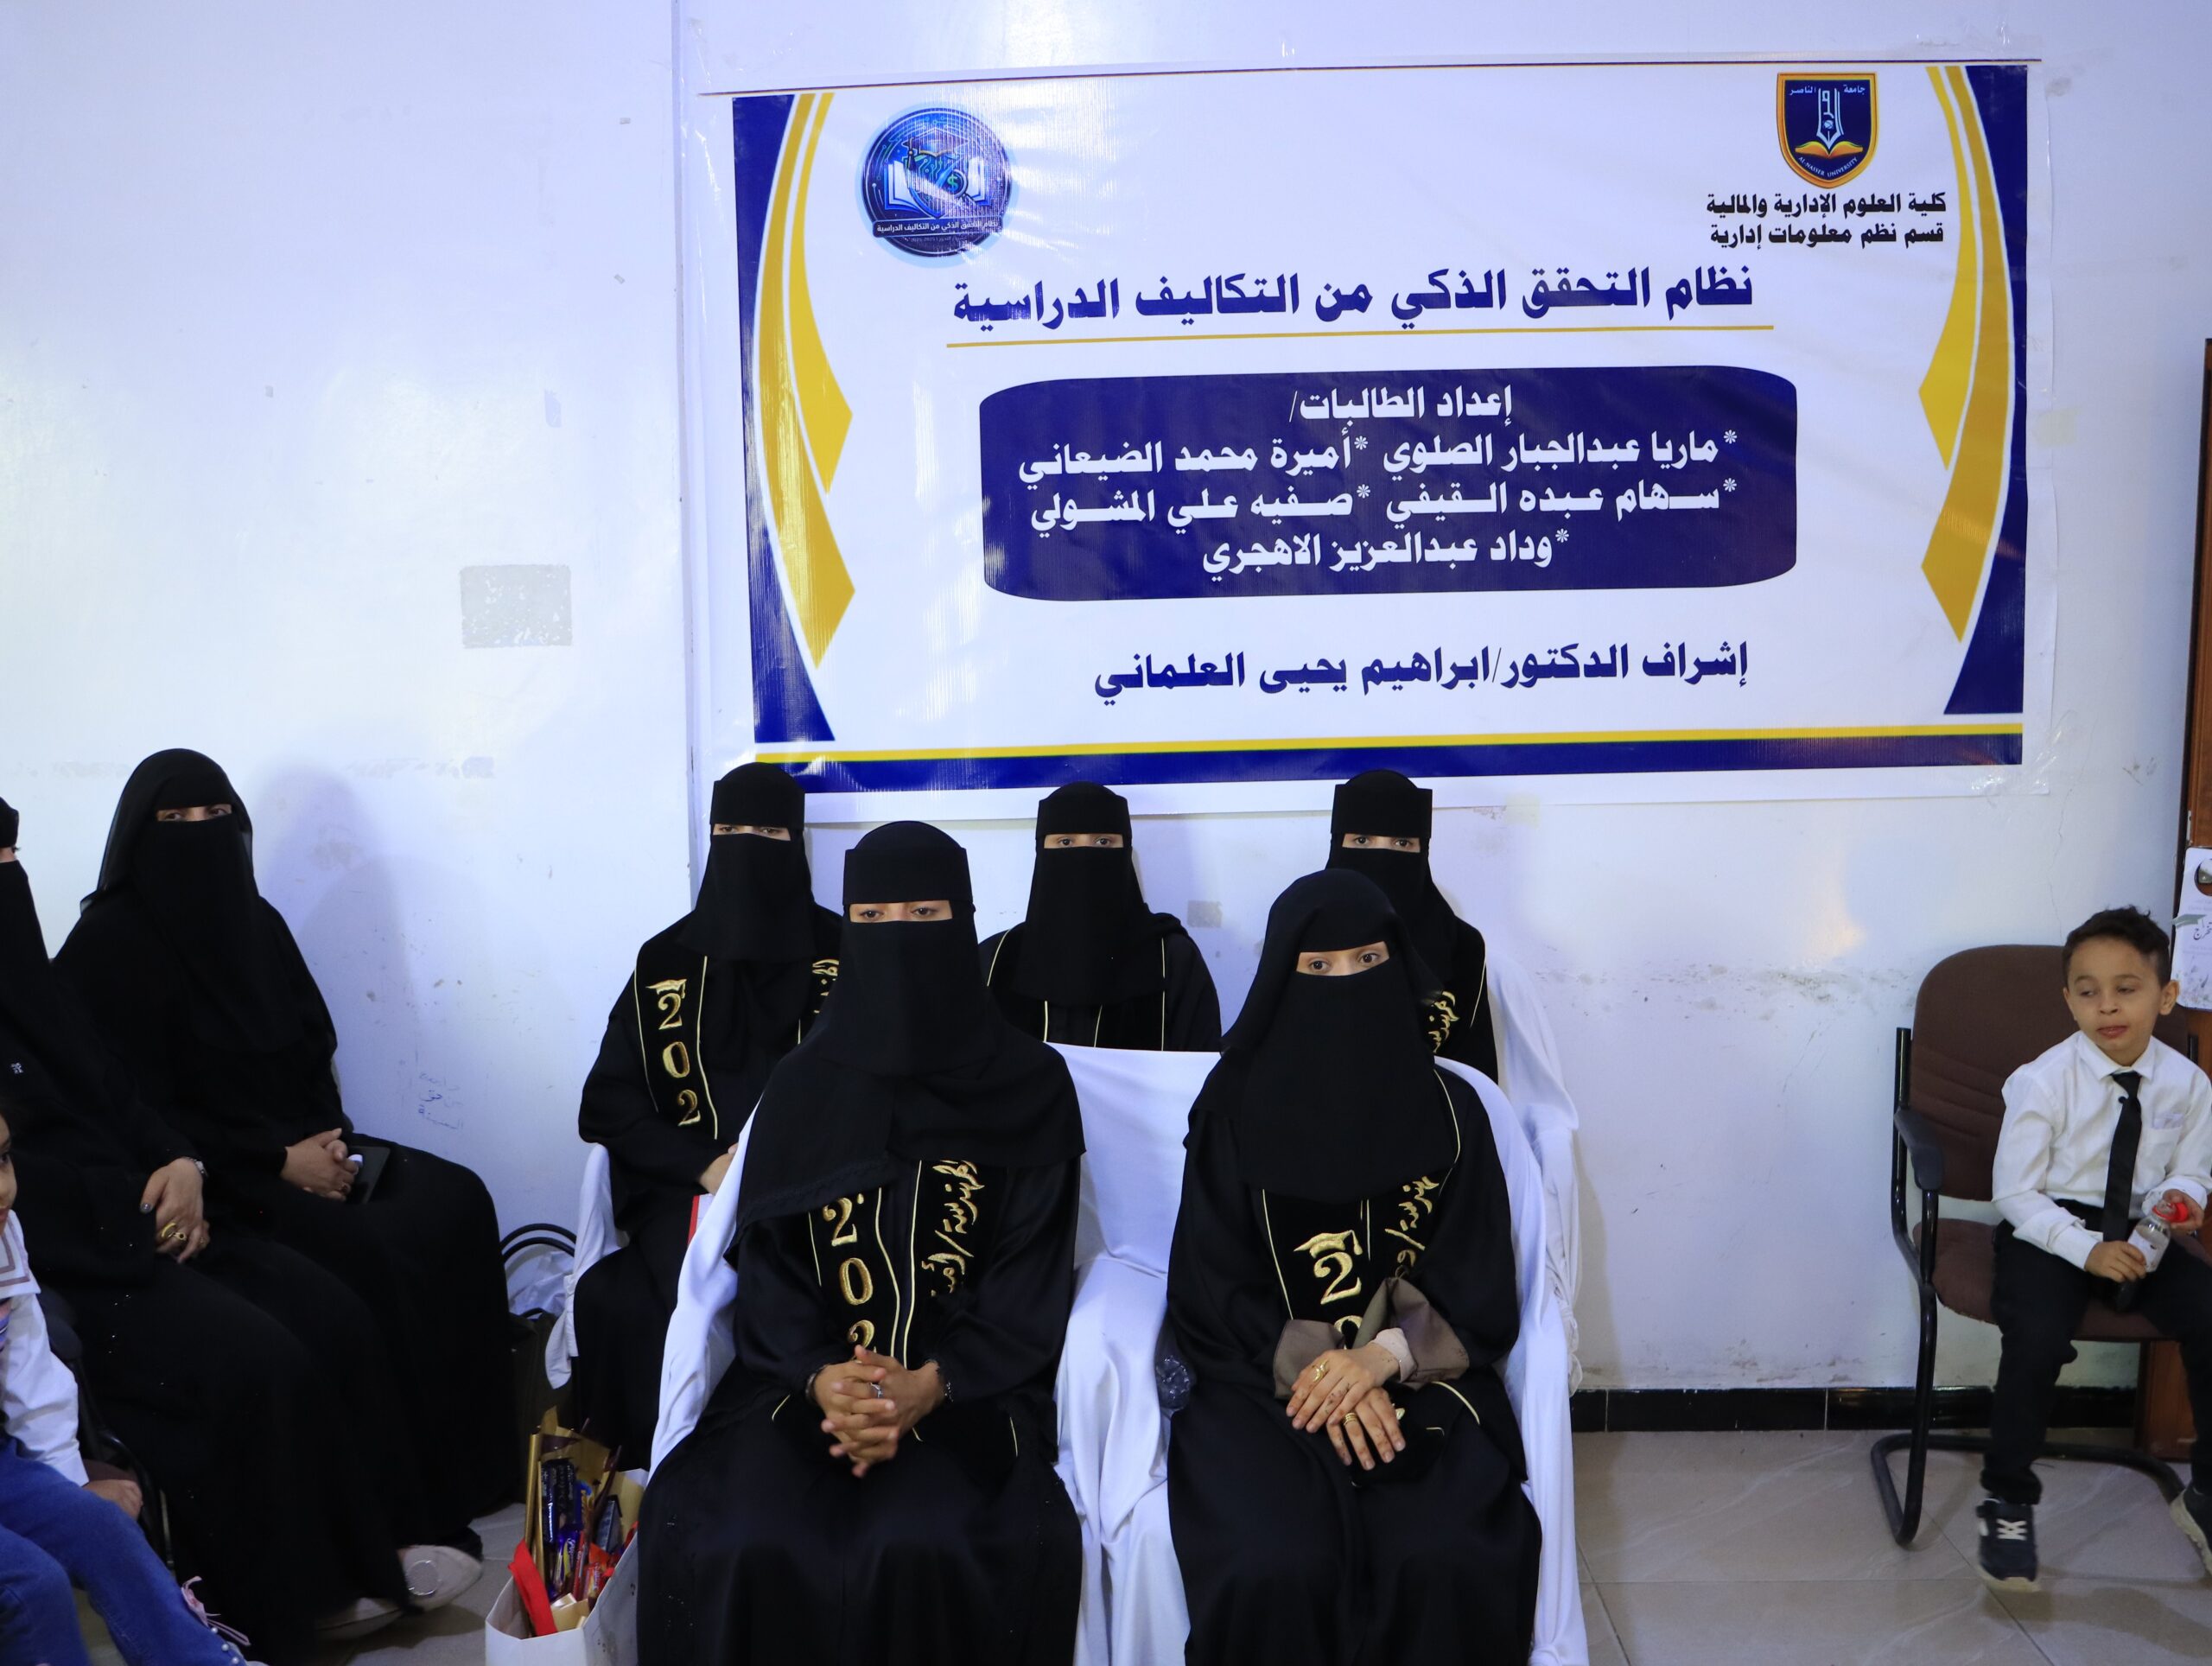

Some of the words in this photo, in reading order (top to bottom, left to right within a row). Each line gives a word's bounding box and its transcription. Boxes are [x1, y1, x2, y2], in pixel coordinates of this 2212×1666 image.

[1789, 85, 1816, 96] الناصر
[1843, 84, 1866, 95] جامعة
[1798, 156, 1825, 176] AL-NASSER
[1827, 156, 1859, 177] UNIVERSITY
[1707, 194, 1768, 219] والمالية
[1773, 193, 1837, 219] الإدارية
[1843, 193, 1902, 219] العلوم
[1908, 192, 1947, 217] كلية
[876, 224, 903, 234] الدراسية
[904, 222, 930, 233] التكاليف
[930, 223, 940, 232] من
[941, 221, 959, 232] الذكي
[1710, 224, 1762, 250] إدارية
[1768, 223, 1853, 248] معلومات
[1860, 222, 1897, 250] نظم
[1904, 222, 1944, 249] قسم
[953, 277, 1120, 332] الدراسية
[1135, 272, 1300, 326] التكاليف
[1315, 283, 1374, 322] من
[1390, 268, 1507, 330] الذكي
[1522, 266, 1650, 320] التحقق
[1665, 264, 1753, 321] نظام
[1288, 386, 1425, 427] الطالبات/
[1437, 385, 1512, 426] إعداد
[1019, 441, 1163, 491] الضيعاني
[1174, 446, 1258, 473] محمد
[1270, 427, 1351, 477] أميرة
[1383, 433, 1493, 481] الصلوي
[1500, 431, 1640, 472] عبدالجبار
[1651, 430, 1719, 469] ماريا
[1031, 489, 1155, 538] المشولي
[1167, 487, 1239, 535] علي
[1250, 485, 1353, 525] صفيه
[1386, 481, 1508, 530] القيفي
[1519, 486, 1604, 519] عبده
[1616, 479, 1719, 522] سهام
[1203, 532, 1321, 582] الاهجري
[1329, 531, 1478, 572] عبدالعزيز
[1490, 529, 1553, 568] وداد
[1094, 651, 1245, 706] العلماني
[1259, 658, 1347, 695] يحيى
[1642, 640, 1748, 688] إشراف
